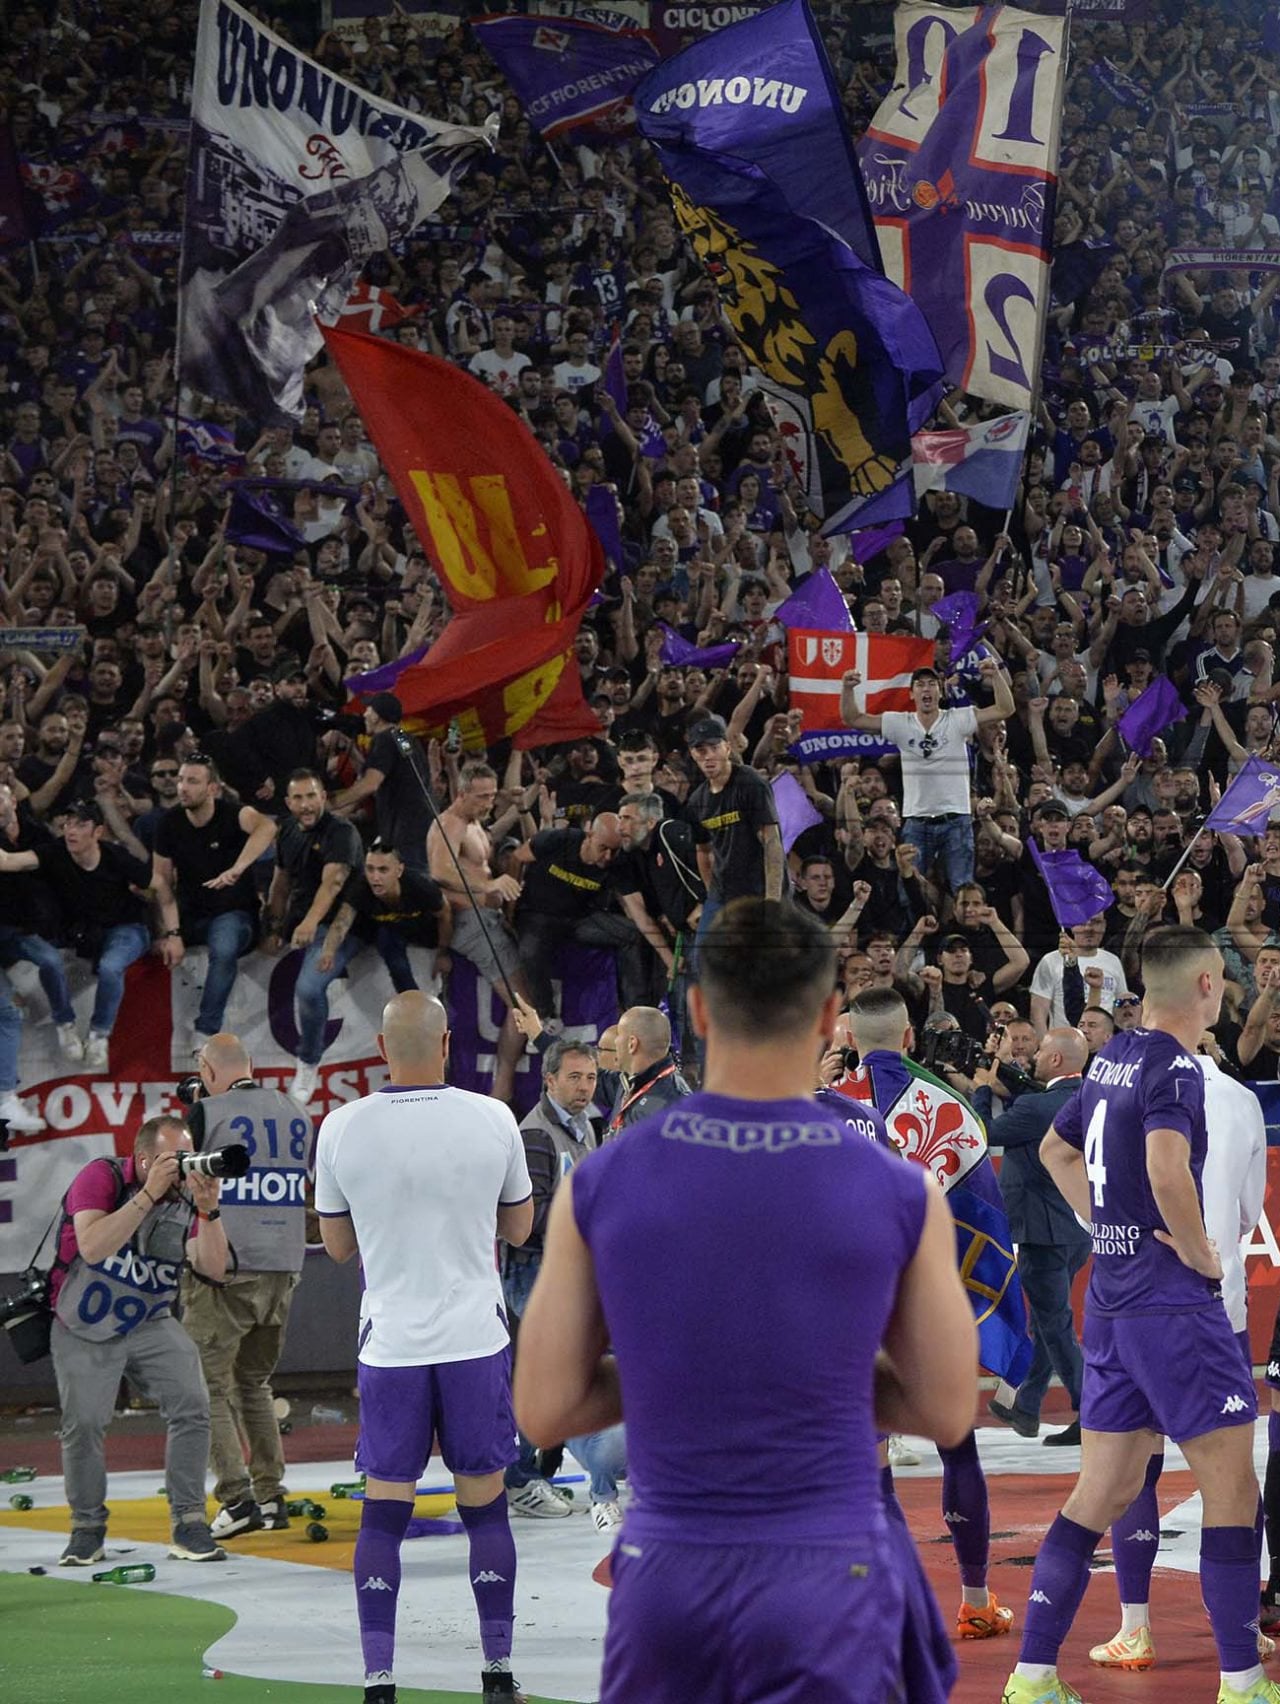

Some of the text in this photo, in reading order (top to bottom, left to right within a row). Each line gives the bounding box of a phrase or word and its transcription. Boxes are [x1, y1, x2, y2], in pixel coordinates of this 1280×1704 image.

[550, 58, 655, 104] FIORENTINA
[230, 1115, 308, 1160] 318
[661, 1111, 842, 1153] Kappa
[1085, 1098, 1108, 1207] 4
[1090, 1223, 1141, 1240] OLDING
[1091, 1239, 1137, 1256] MIONI
